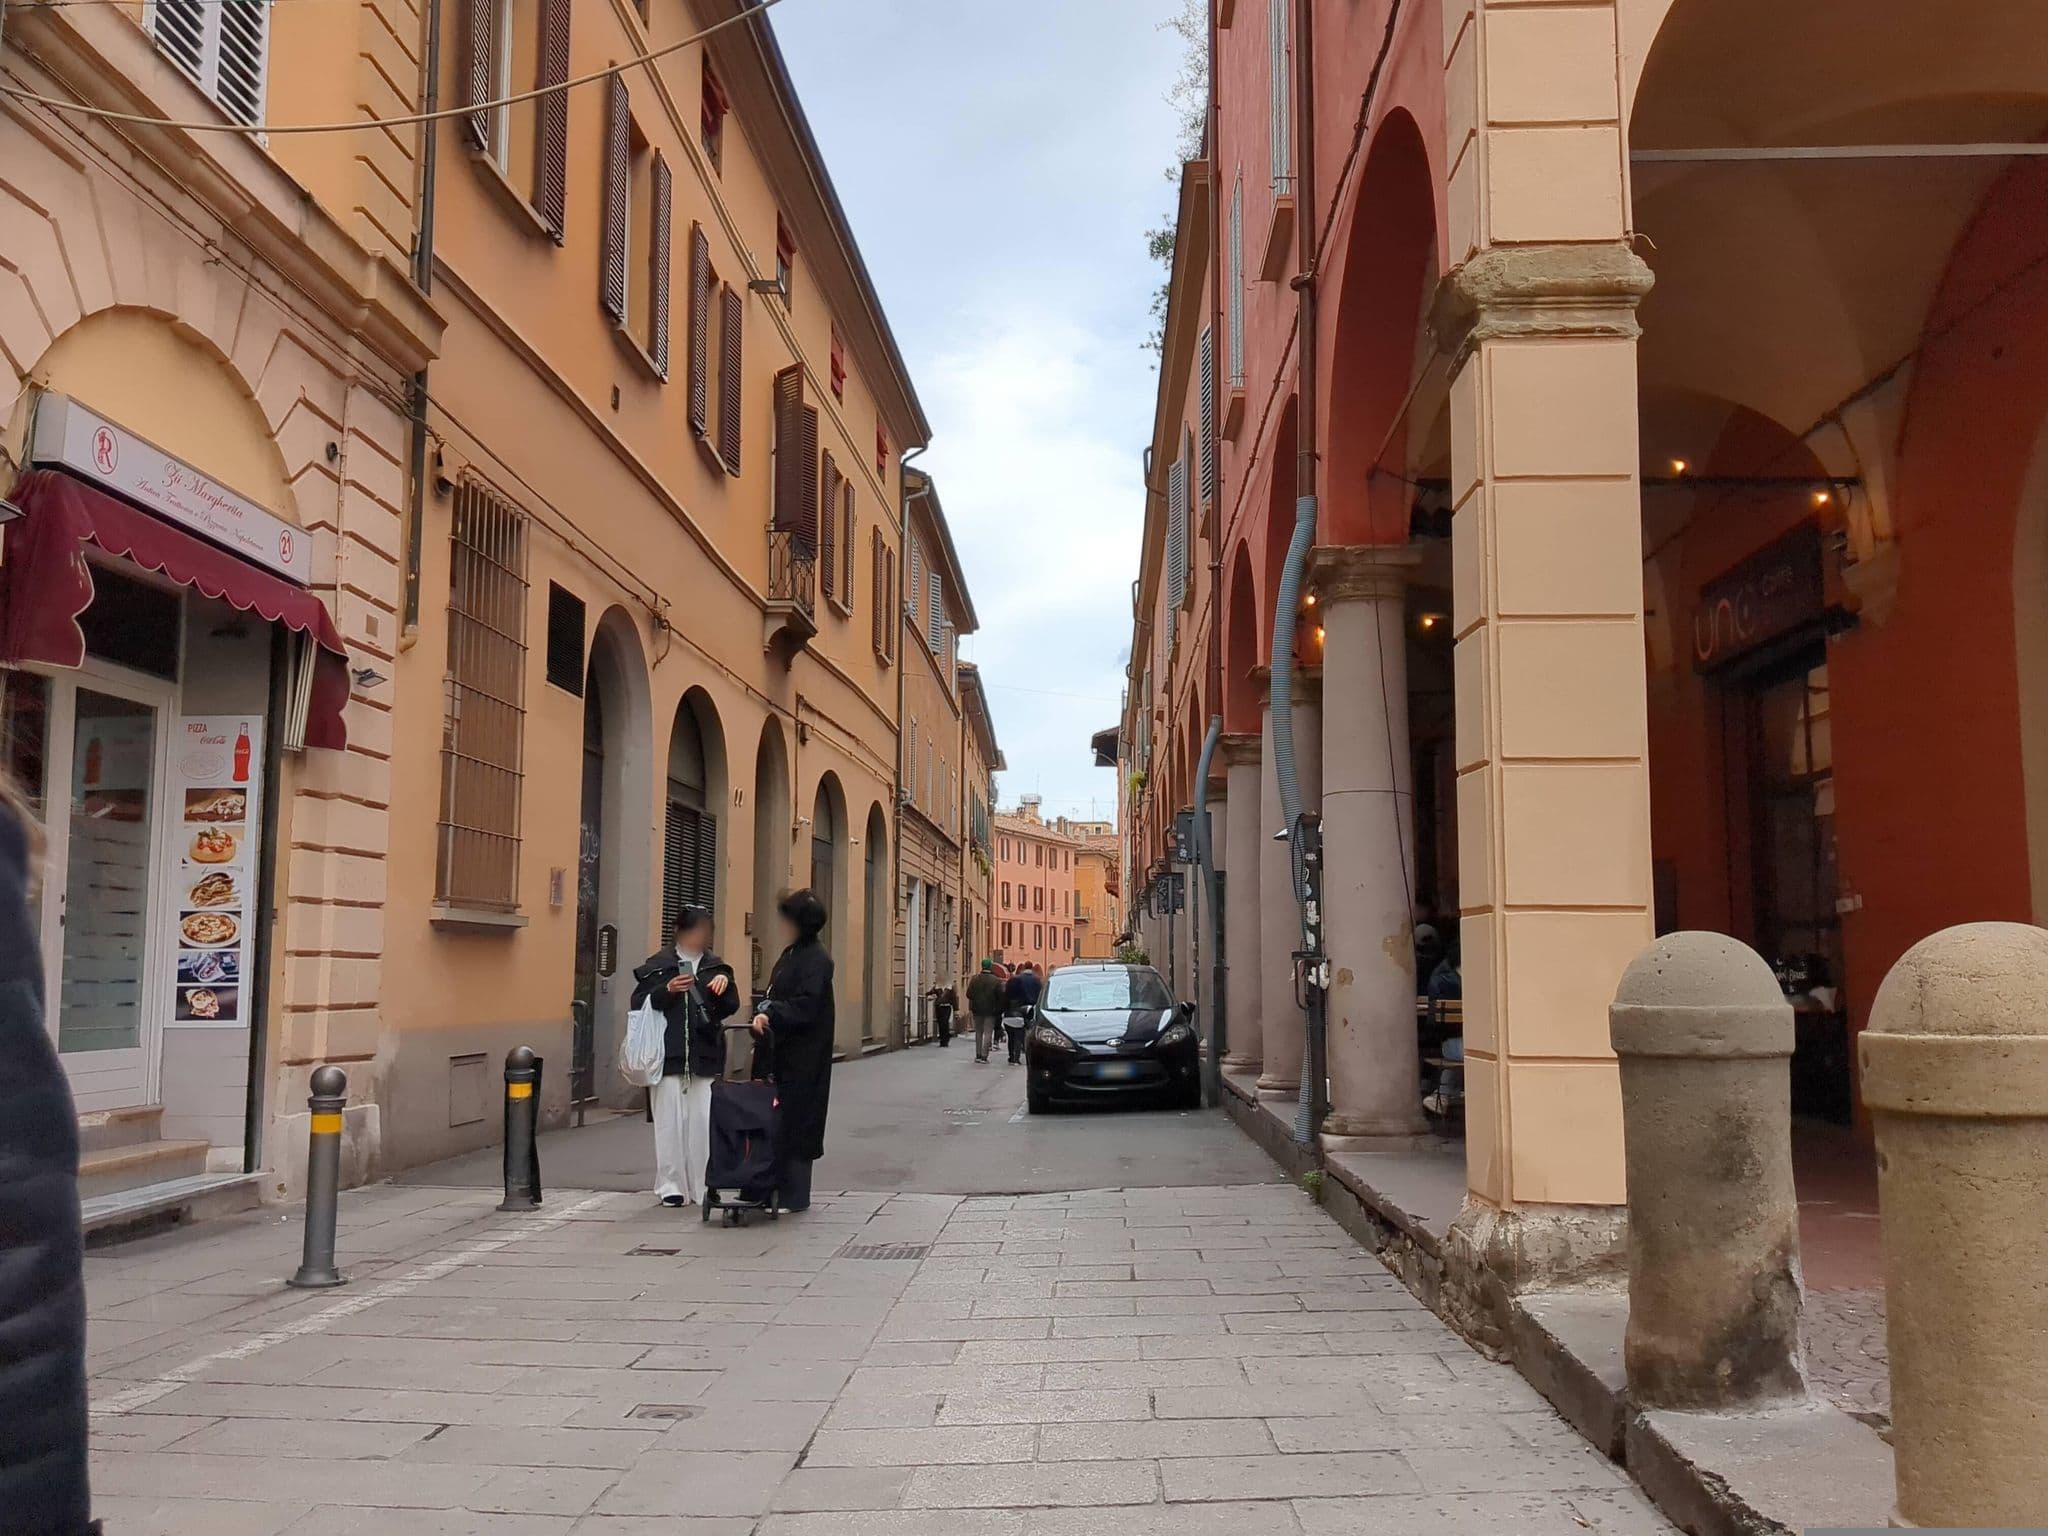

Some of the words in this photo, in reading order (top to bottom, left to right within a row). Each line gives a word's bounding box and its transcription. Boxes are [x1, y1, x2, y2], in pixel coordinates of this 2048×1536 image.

[184, 472, 243, 518] Margherita
[281, 536, 291, 555] 21
[187, 723, 208, 733] PIZZA
